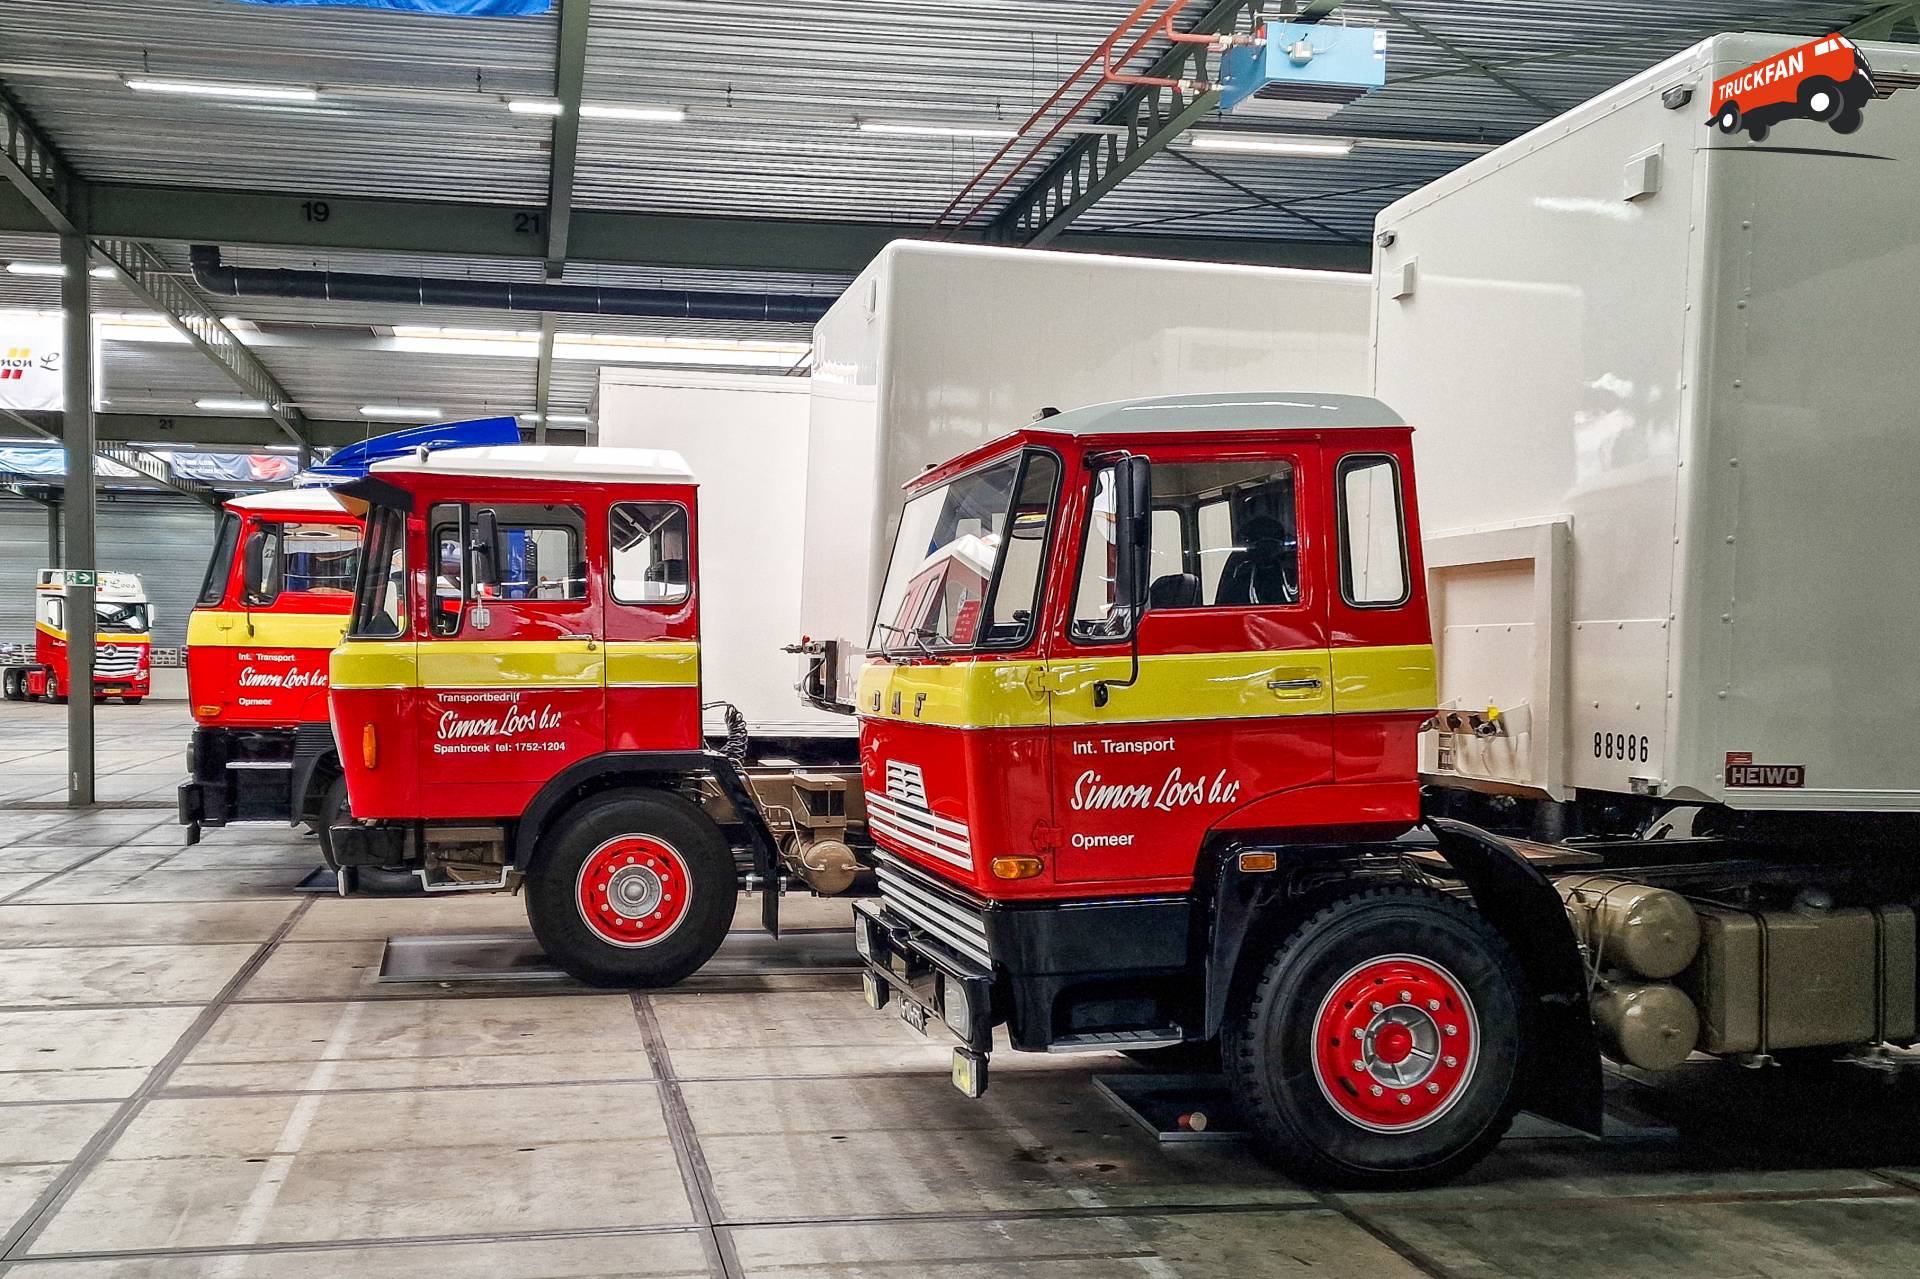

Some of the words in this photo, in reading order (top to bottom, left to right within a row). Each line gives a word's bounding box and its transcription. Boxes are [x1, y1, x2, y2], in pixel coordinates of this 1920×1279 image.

[302, 202, 330, 222] 19
[514, 213, 541, 233] 21
[256, 653, 296, 662] Transport
[239, 666, 282, 687] Simon
[282, 667, 309, 689] Loos
[238, 698, 272, 706] Opmeer
[437, 692, 520, 703] Transportbedrijf
[872, 690, 927, 718] DAF
[437, 710, 498, 740] Simon
[496, 704, 536, 737] Loos
[433, 743, 490, 755] Spanbroek
[495, 743, 512, 753] tel:
[514, 741, 566, 752] 1752-1204
[1073, 740, 1098, 755] Int.
[1101, 737, 1176, 755] Transport
[1593, 731, 1649, 763] 88986
[1731, 766, 1800, 786] HEIWO
[1070, 769, 1153, 811] Simon
[1153, 766, 1206, 812] Loos
[1071, 833, 1135, 850] Opmeer
